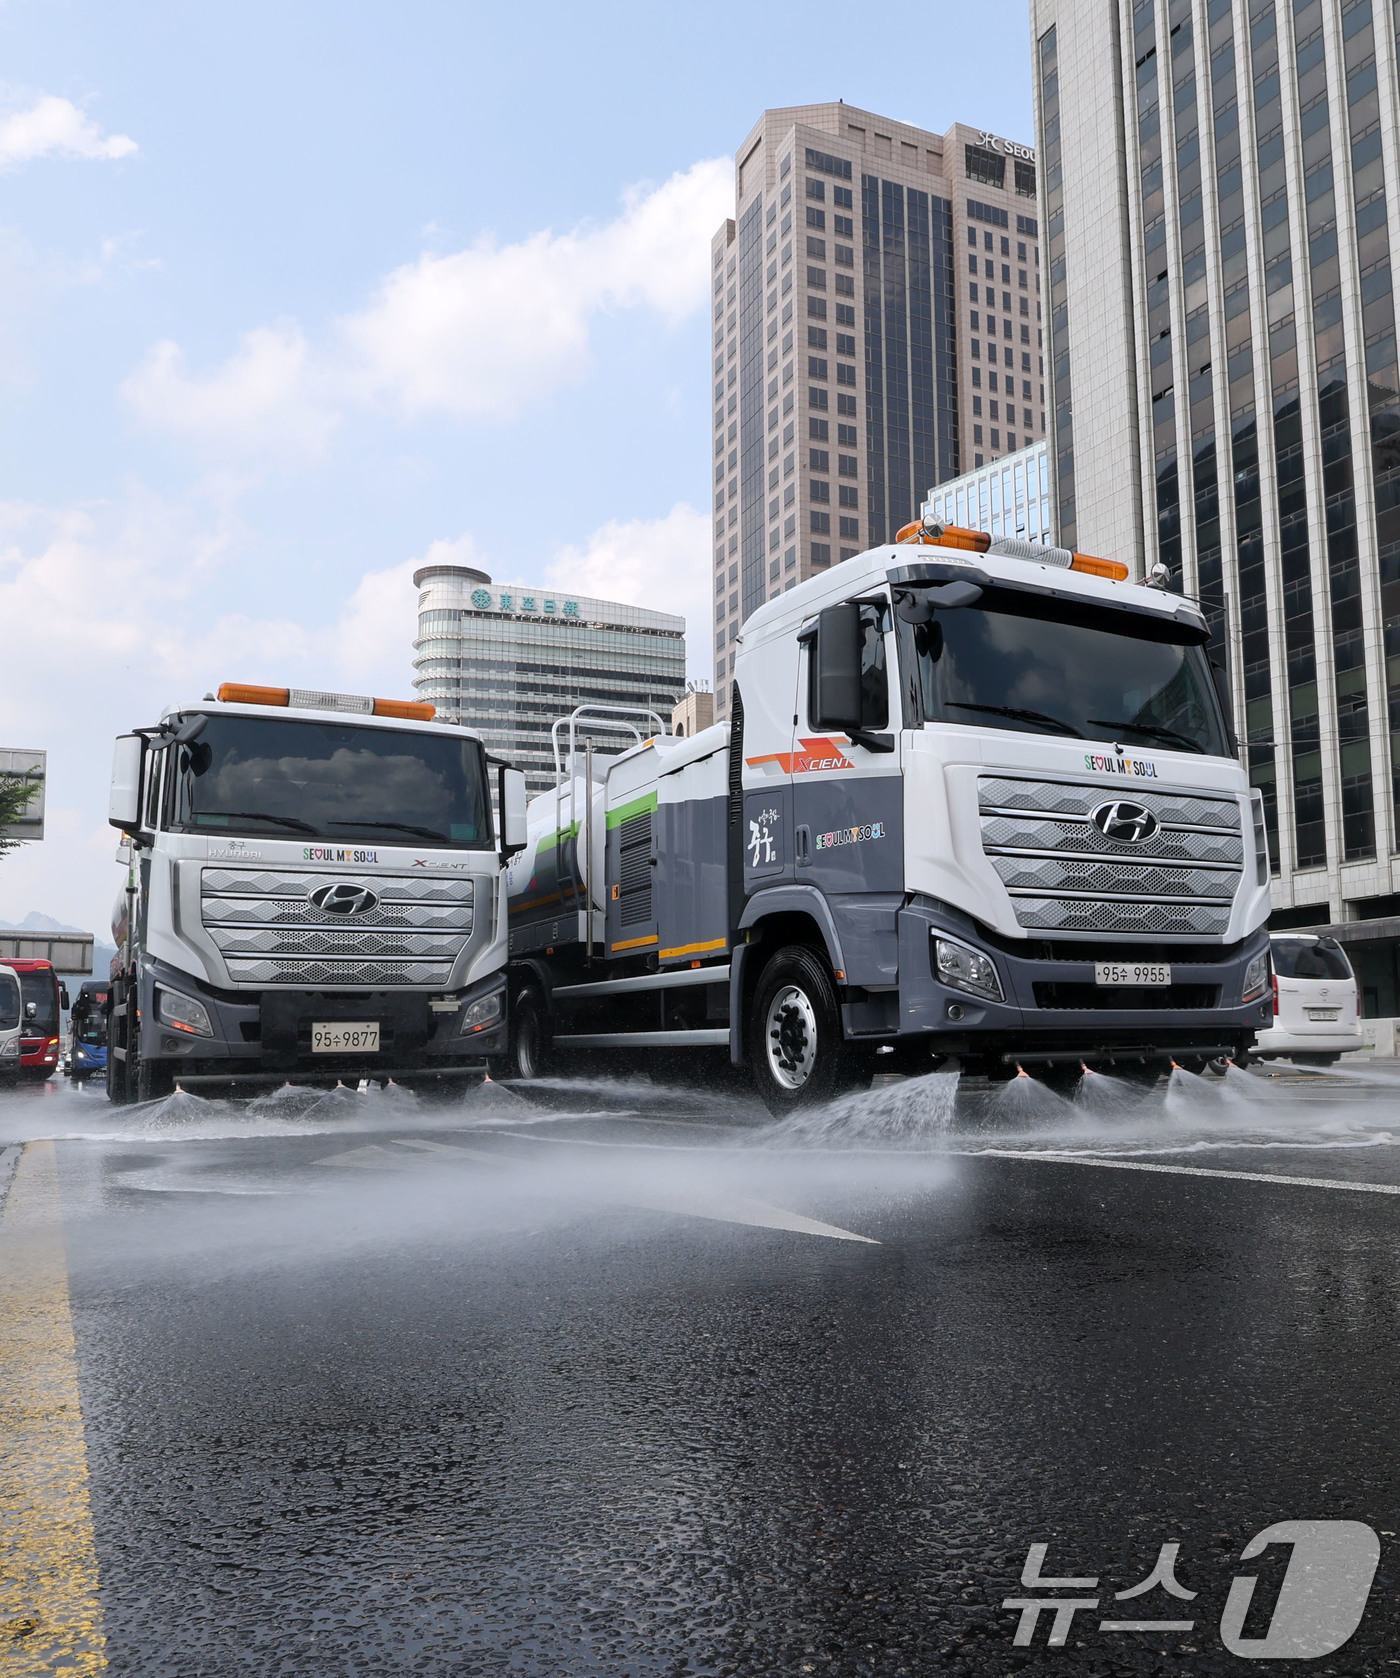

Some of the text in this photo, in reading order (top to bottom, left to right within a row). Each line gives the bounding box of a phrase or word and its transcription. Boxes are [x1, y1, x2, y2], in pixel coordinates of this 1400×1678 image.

[975, 131, 1036, 162] SFC SEOU
[499, 591, 580, 618] 東亞日報
[794, 756, 854, 773] XCIENT
[209, 849, 262, 860] HYUNDAI
[411, 859, 468, 869] XCIENT
[1102, 966, 1165, 982] 95수 9955
